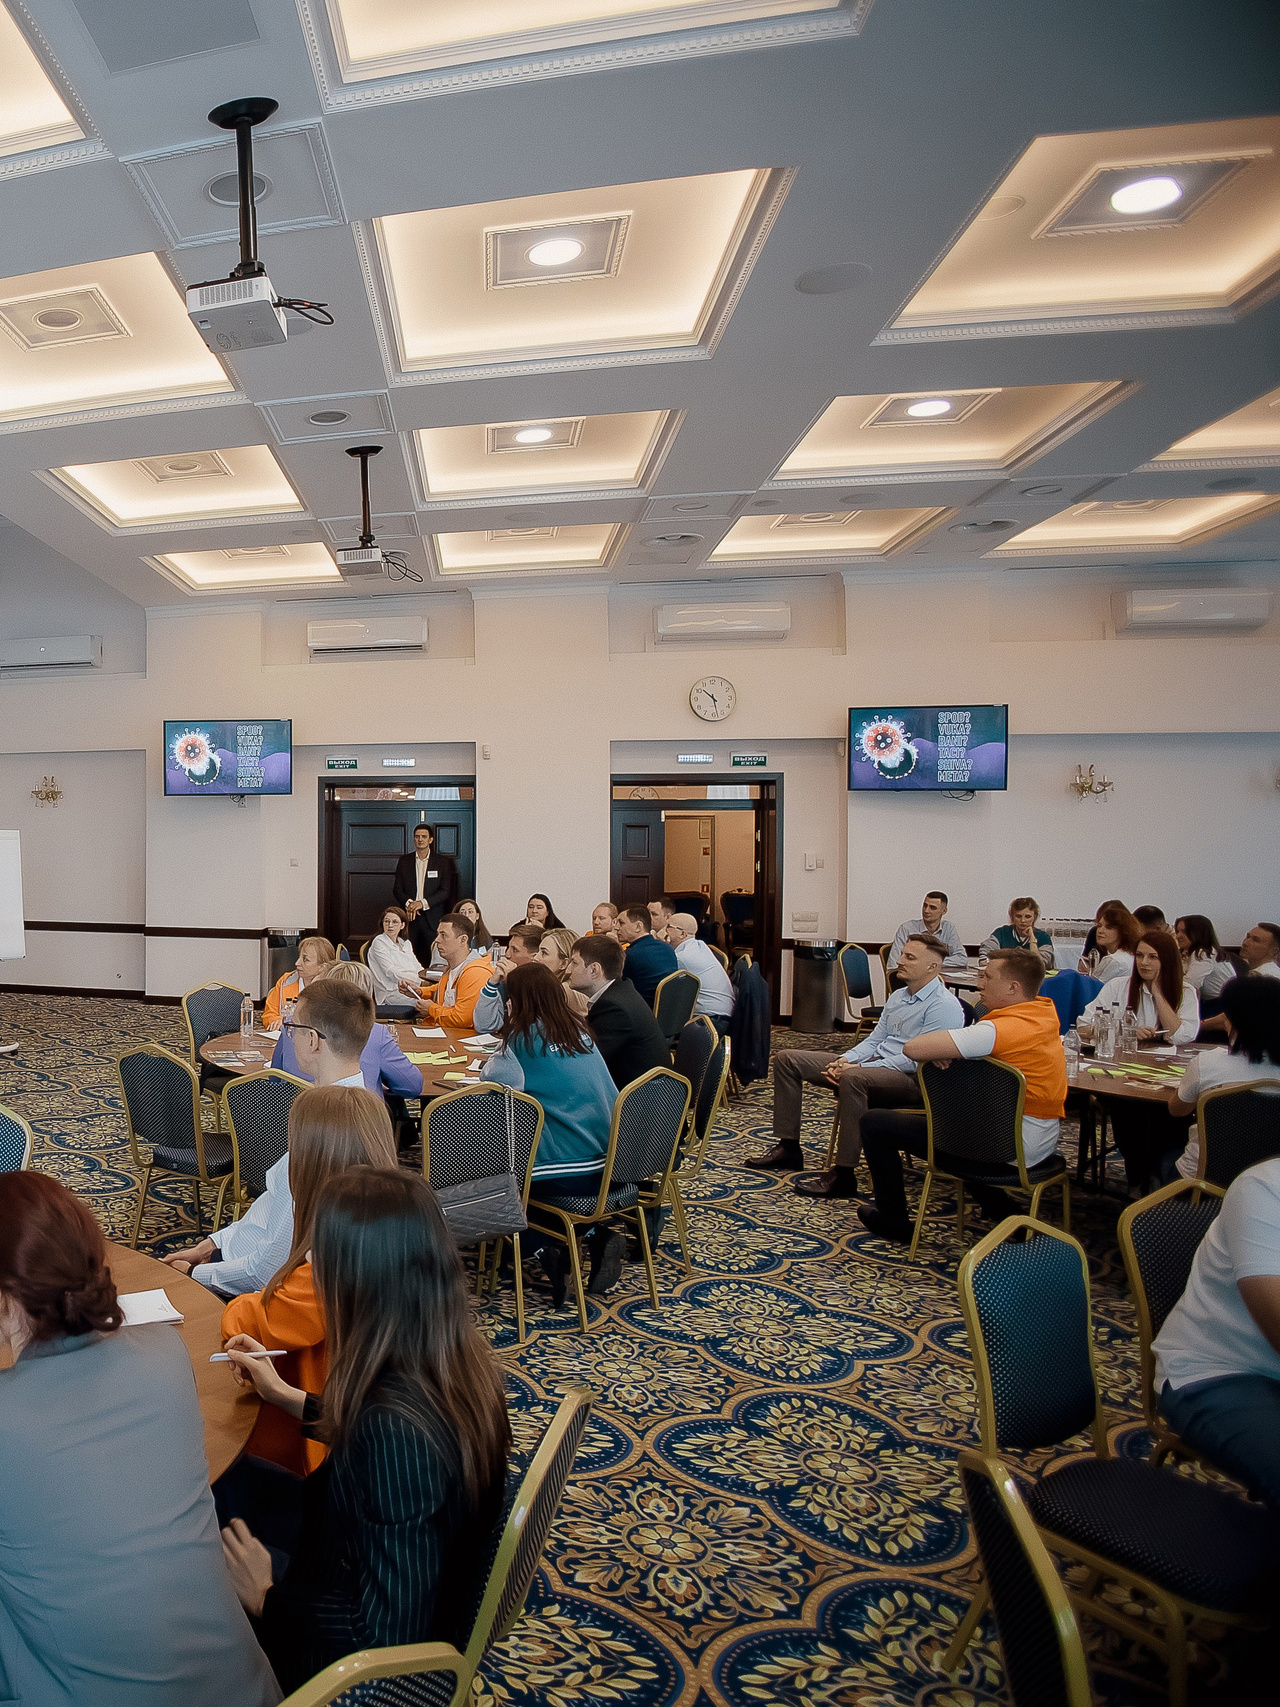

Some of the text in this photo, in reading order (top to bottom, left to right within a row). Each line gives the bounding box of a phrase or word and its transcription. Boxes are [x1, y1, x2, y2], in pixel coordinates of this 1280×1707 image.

[938, 712, 971, 723] SPOD?
[938, 724, 971, 734] VUKA?
[938, 736, 968, 746] BANI?
[938, 748, 965, 758] TACI?
[938, 759, 973, 770] SHIVA?
[938, 771, 969, 782] META?
